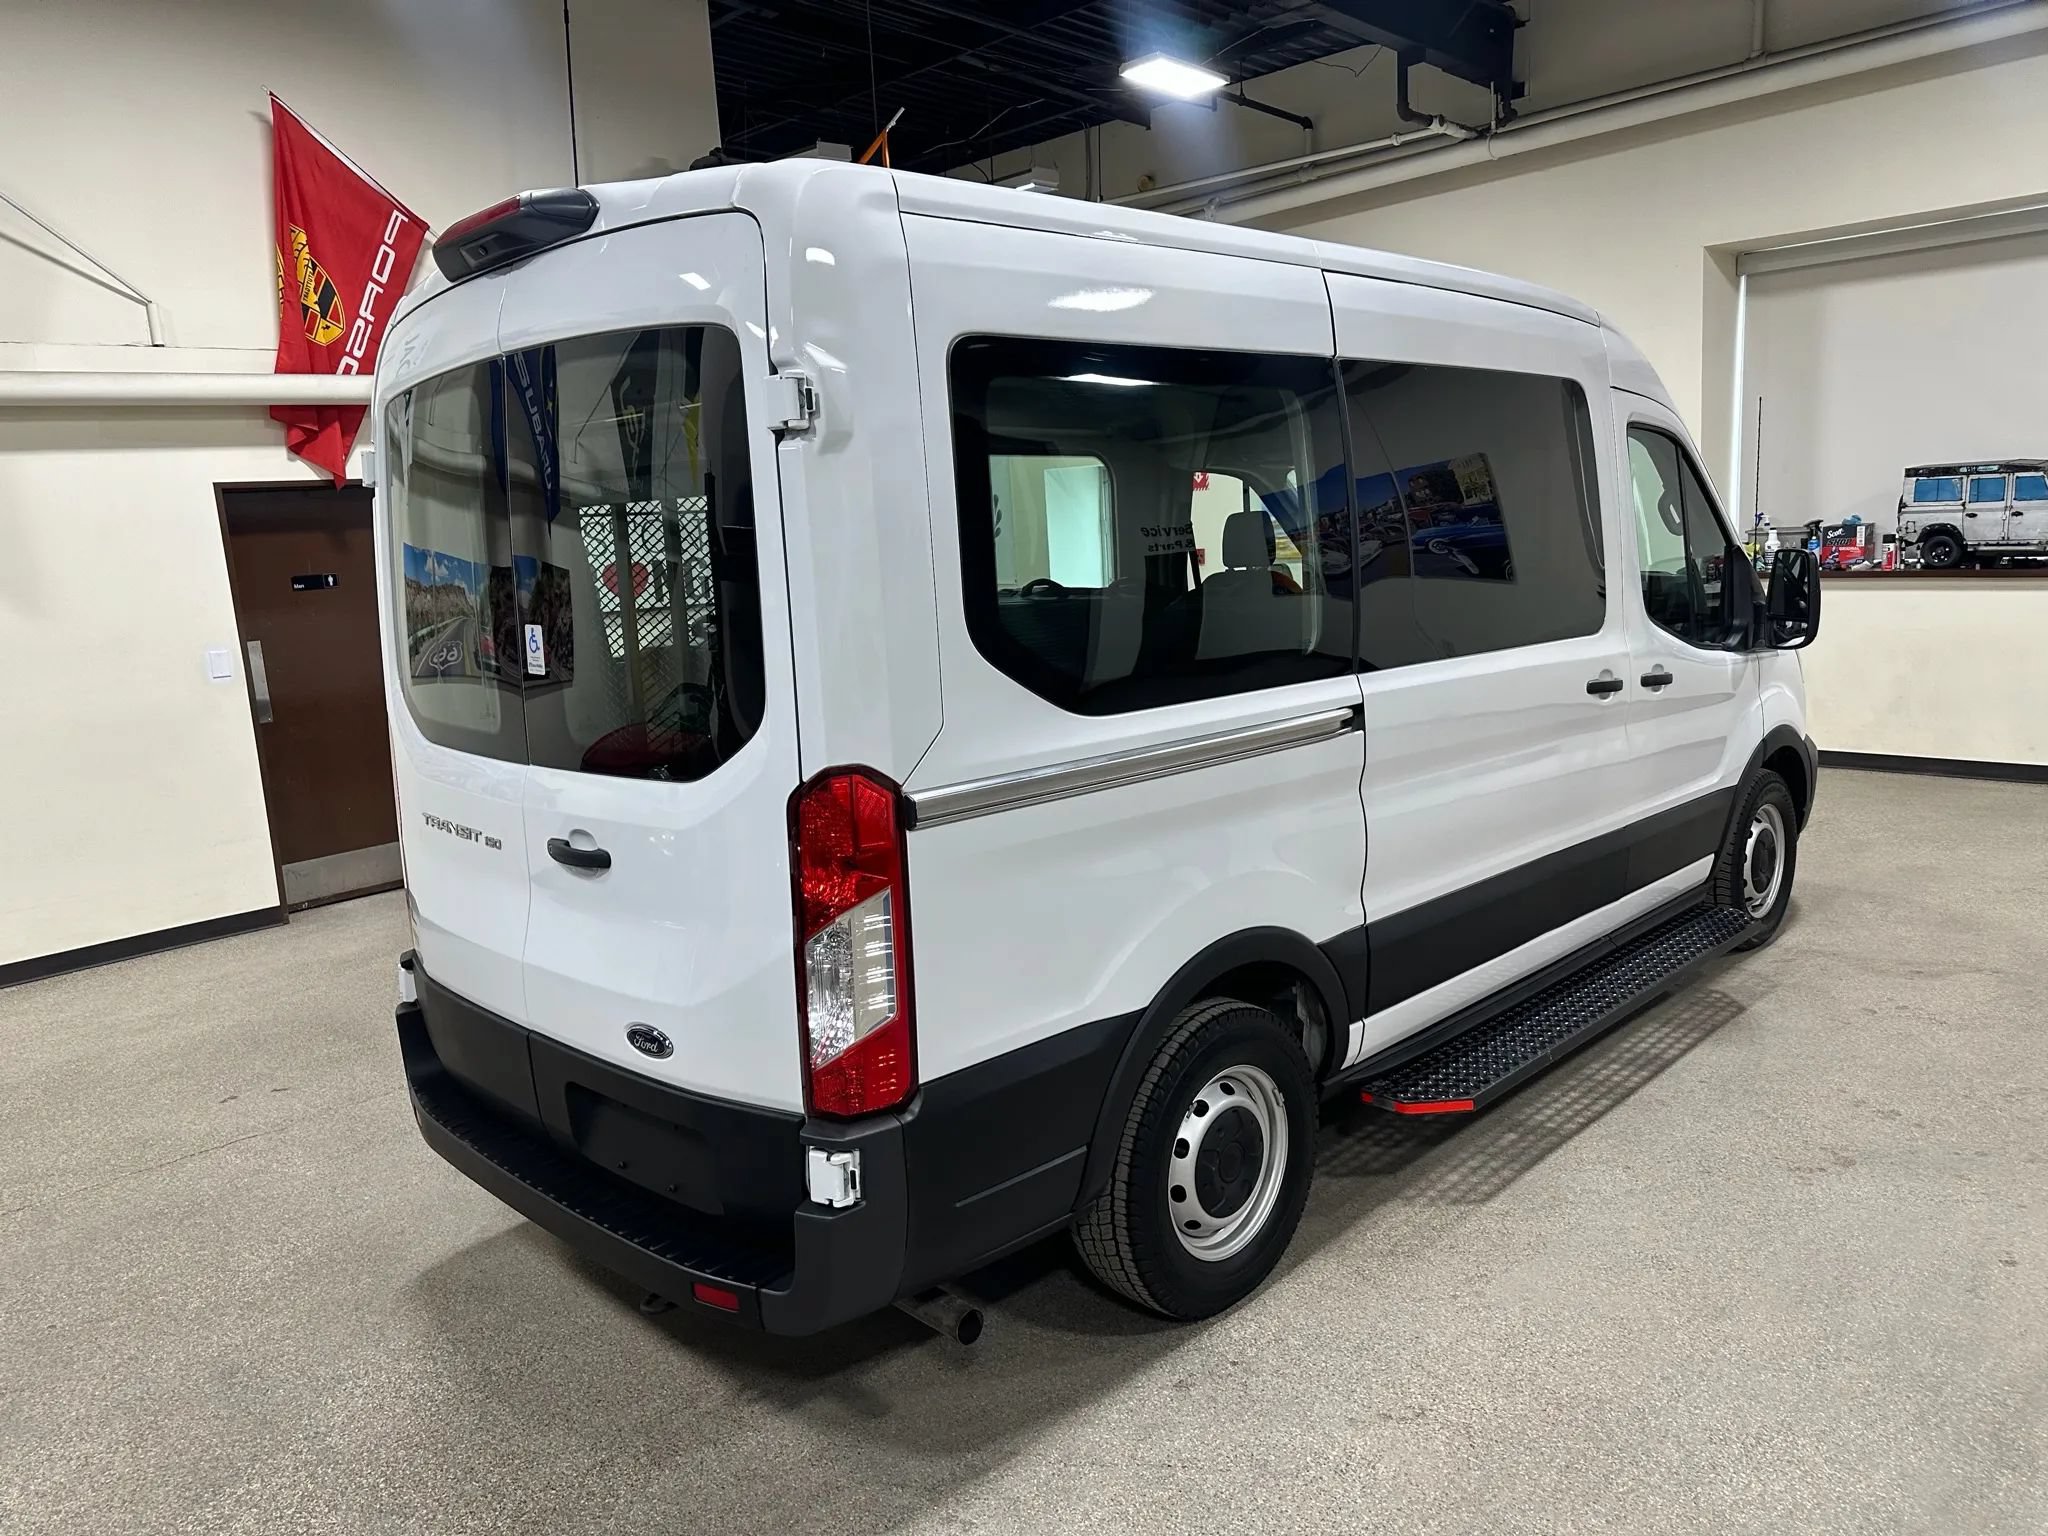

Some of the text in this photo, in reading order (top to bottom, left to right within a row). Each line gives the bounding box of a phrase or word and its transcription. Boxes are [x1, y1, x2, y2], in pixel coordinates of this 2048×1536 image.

[514, 352, 551, 490] SUBARU
[422, 812, 502, 850] TRANSIT 150
[633, 1031, 659, 1053] Ford
